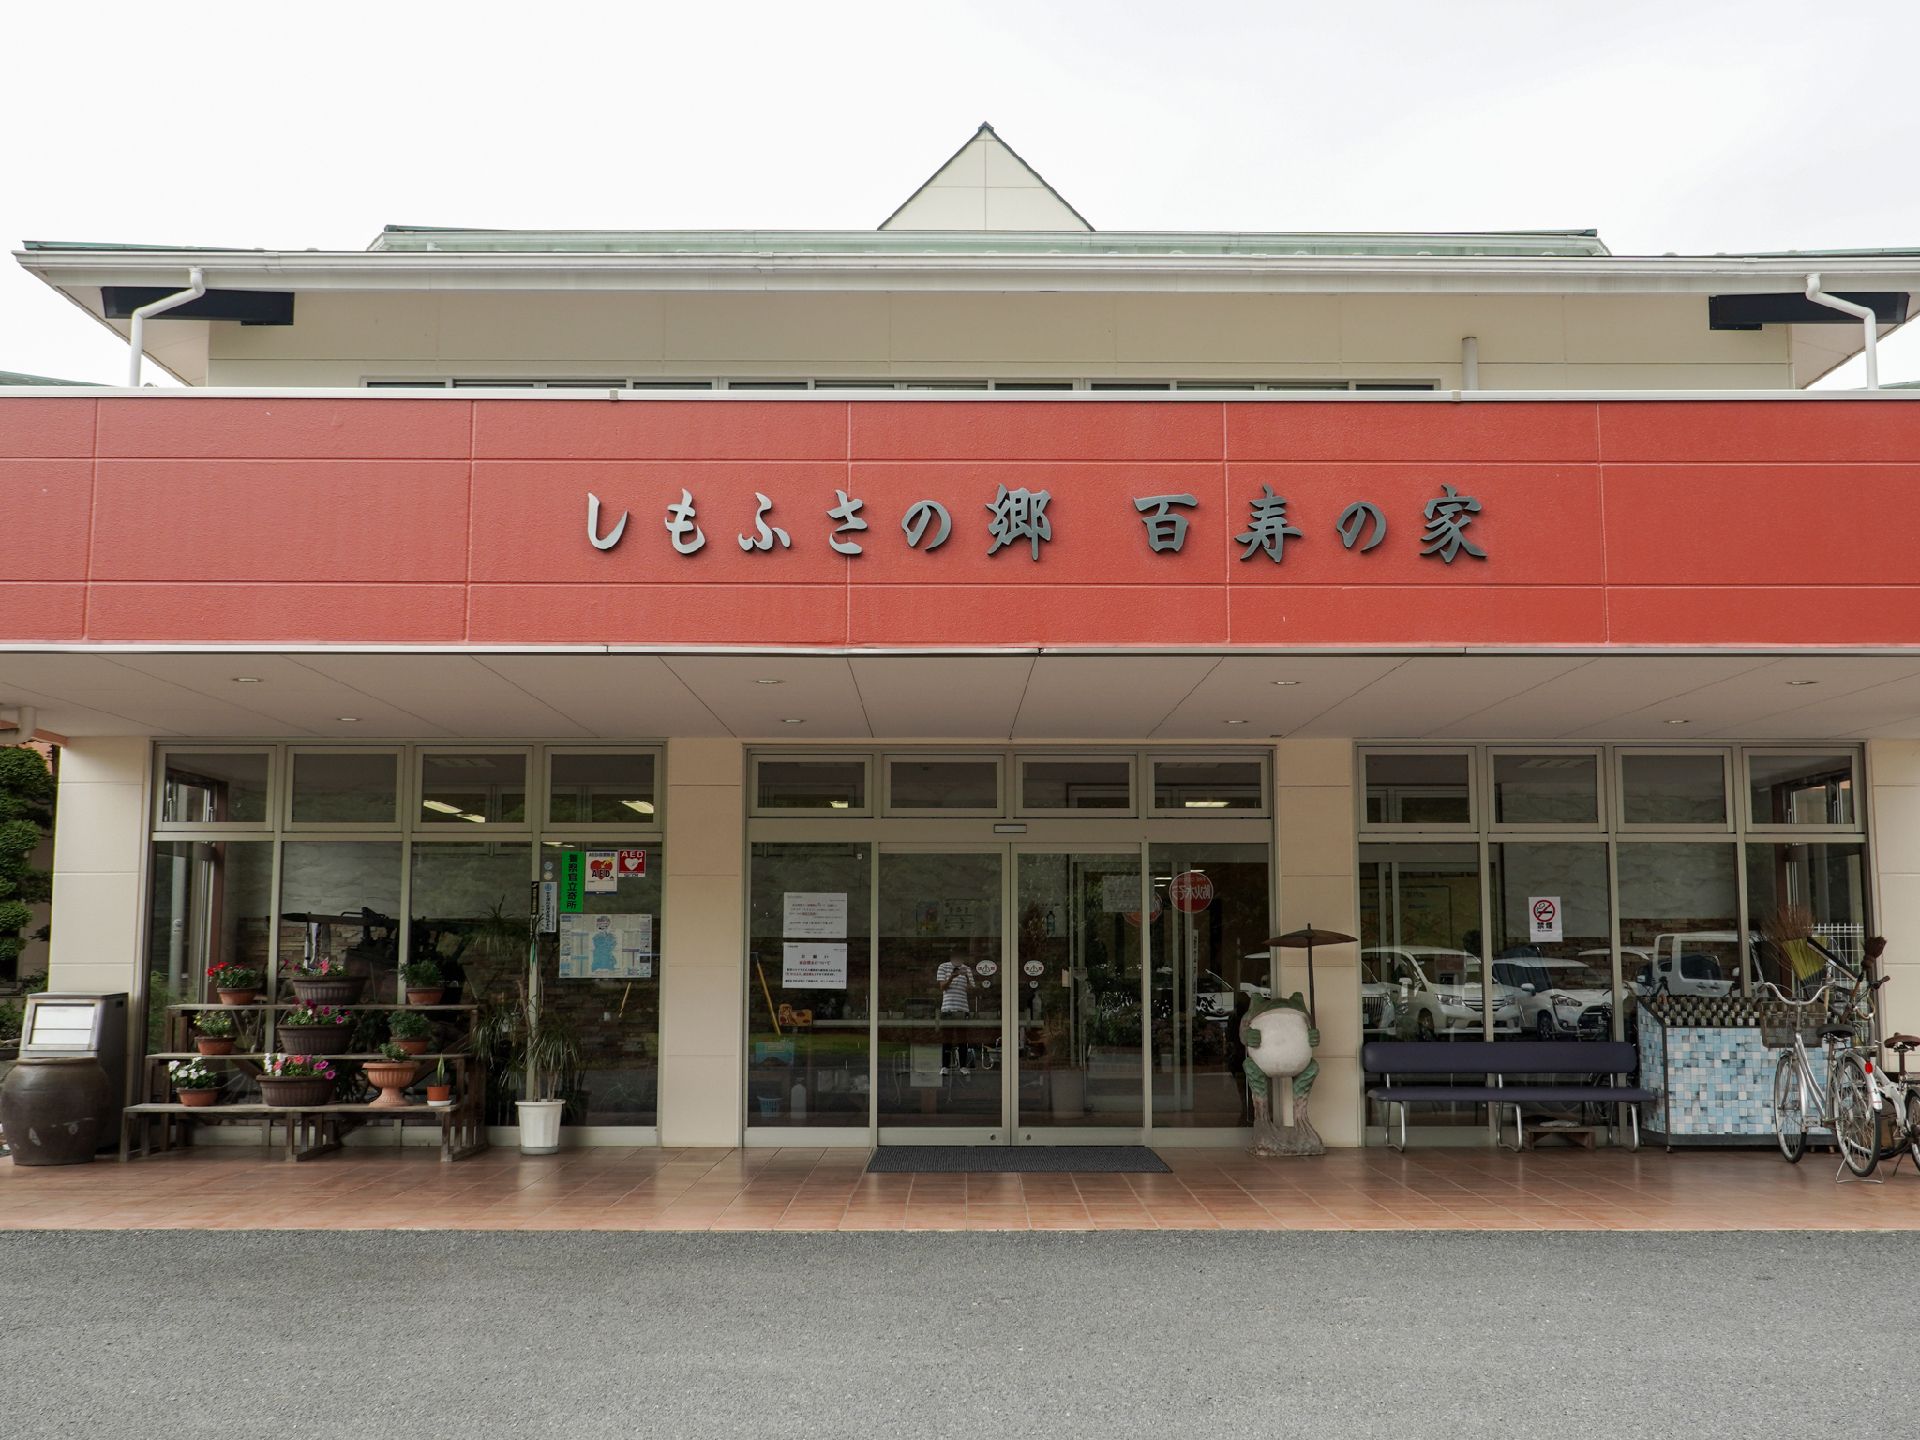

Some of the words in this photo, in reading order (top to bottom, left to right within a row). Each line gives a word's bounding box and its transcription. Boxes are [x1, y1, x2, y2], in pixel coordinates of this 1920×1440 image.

[586, 483, 1052, 561] しもふさの郷
[1133, 483, 1488, 563] 百寿の家
[591, 869, 610, 878] AED
